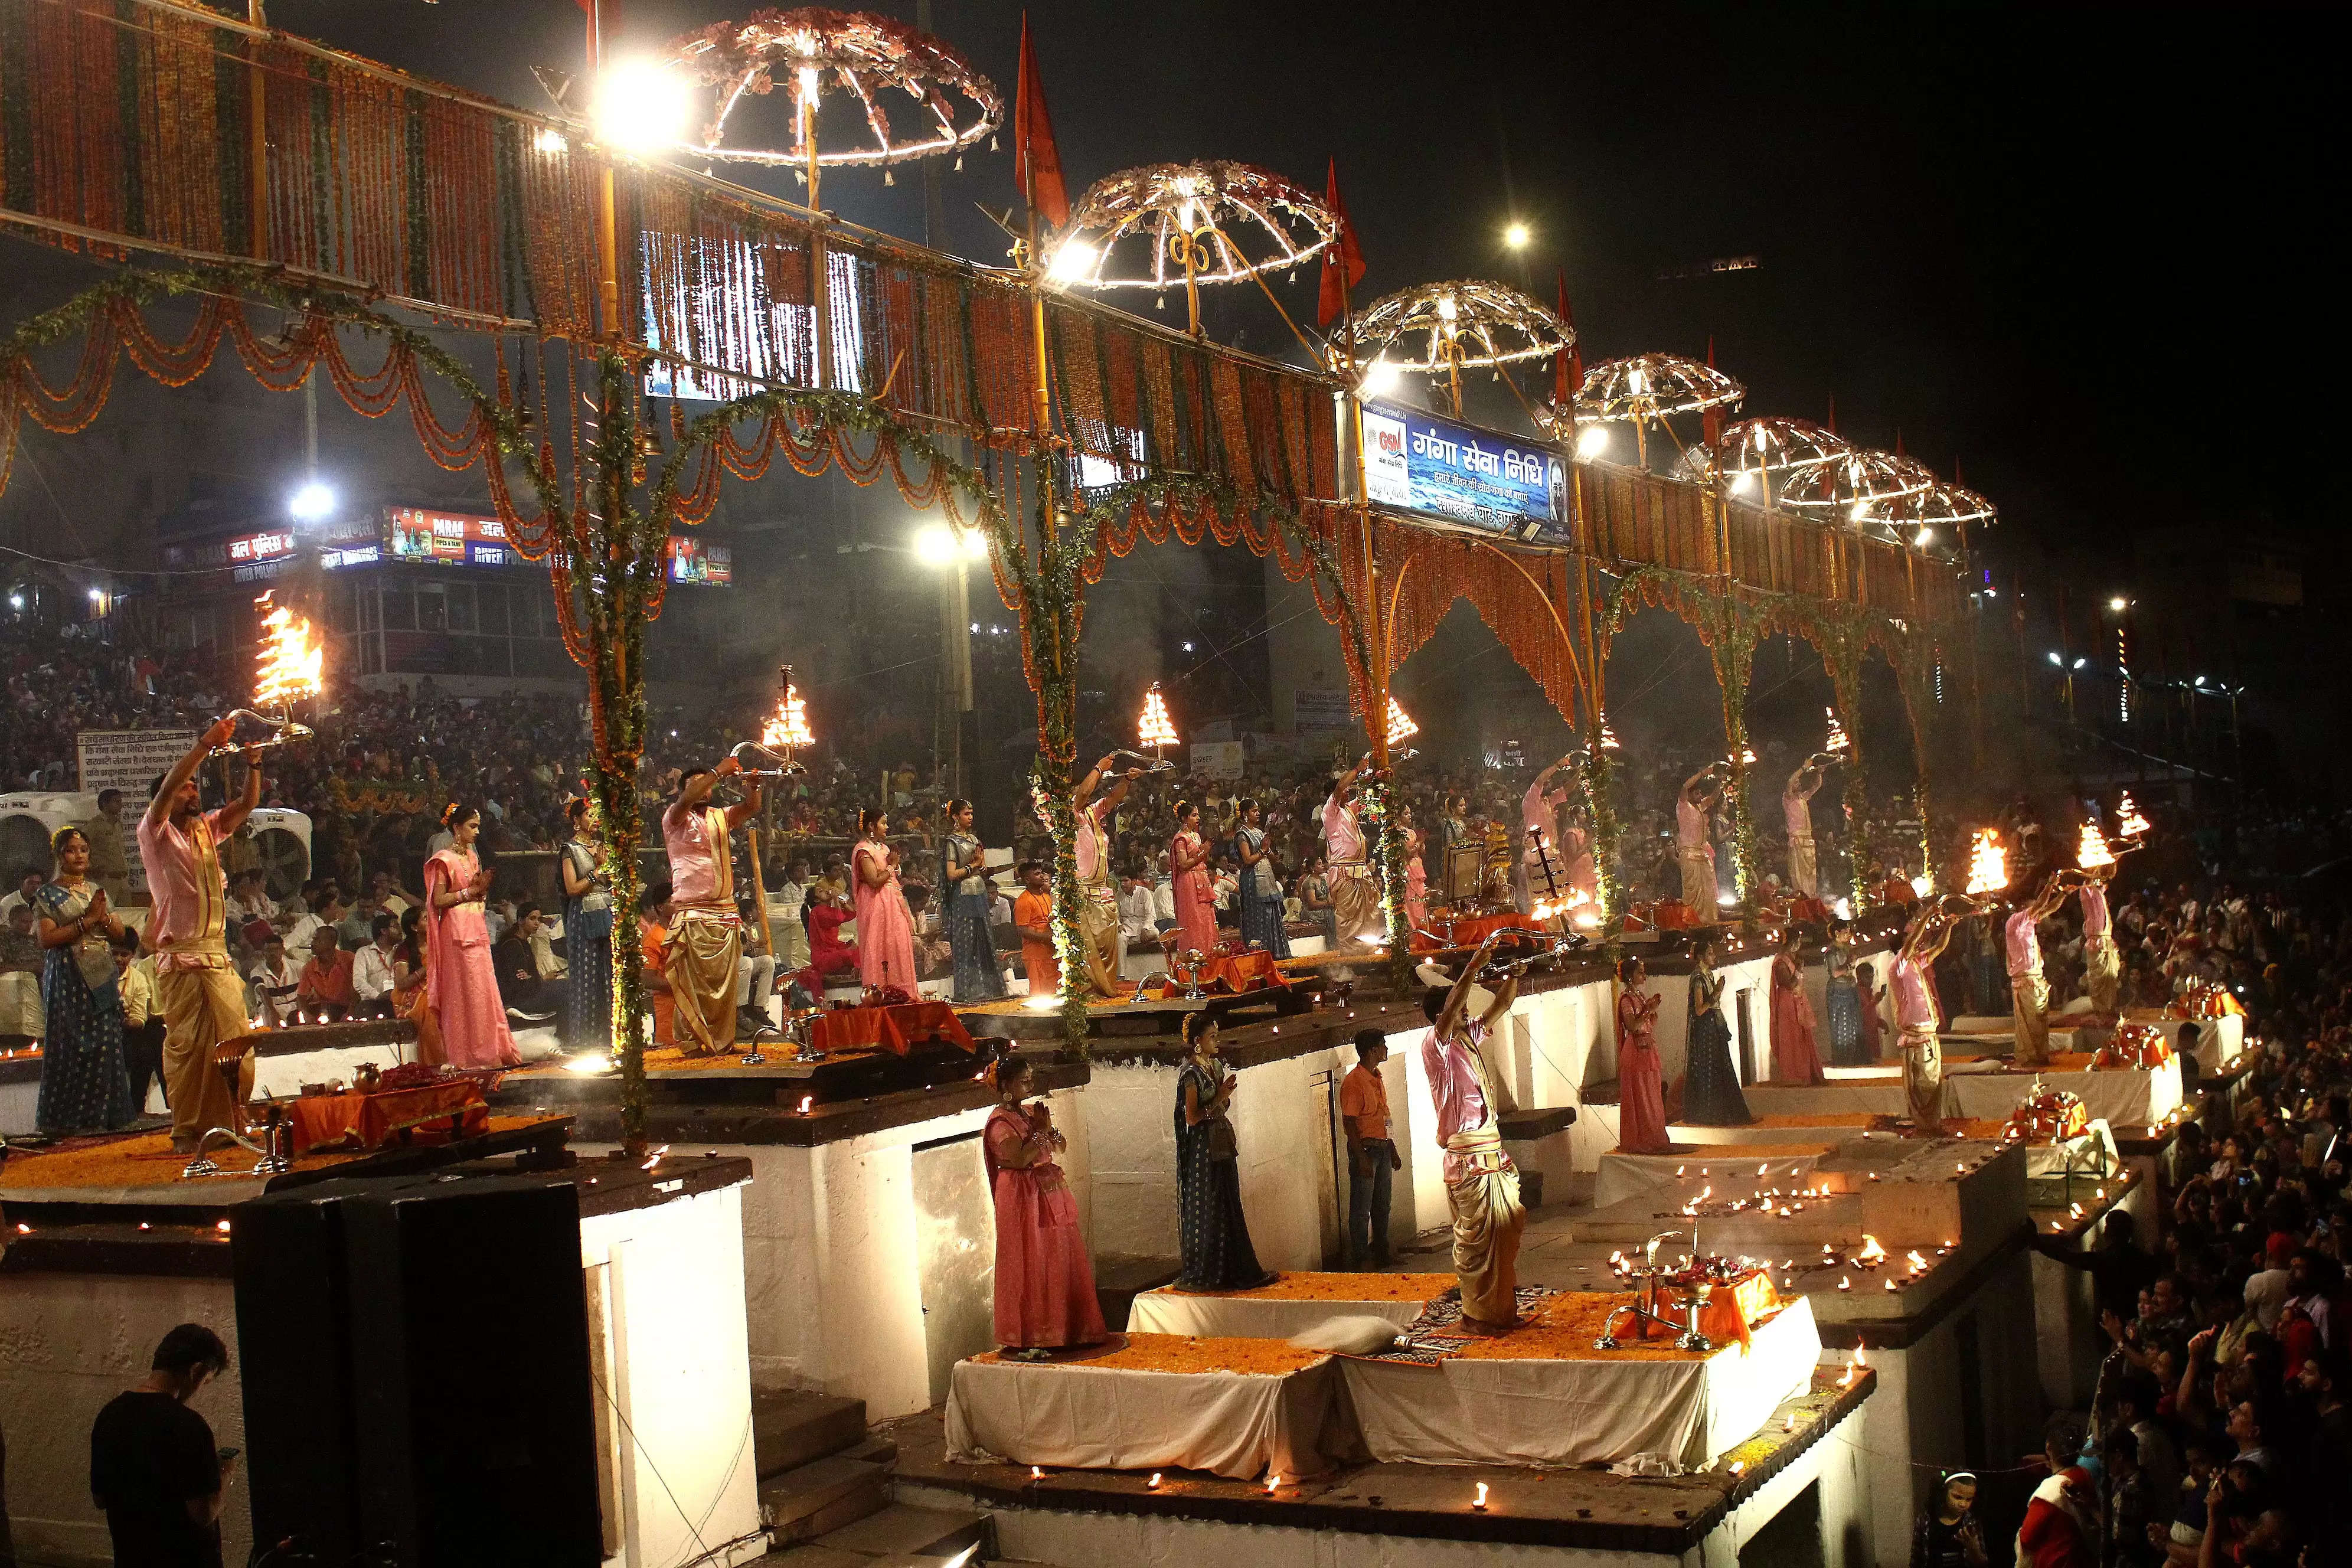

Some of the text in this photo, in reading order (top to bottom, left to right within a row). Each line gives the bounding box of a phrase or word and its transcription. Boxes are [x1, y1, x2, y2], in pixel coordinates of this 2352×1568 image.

[1379, 426, 1401, 452] GSN
[1378, 457, 1387, 465] गंगा
[1412, 427, 1544, 488] गंगा सेवा निधि
[1434, 471, 1451, 485] हमारे
[1451, 472, 1468, 488] जीवन
[1491, 483, 1504, 496] गंगा
[479, 520, 506, 538] जल
[229, 540, 250, 558] जल
[251, 533, 283, 561] पुलिस
[475, 547, 502, 564] RIVER
